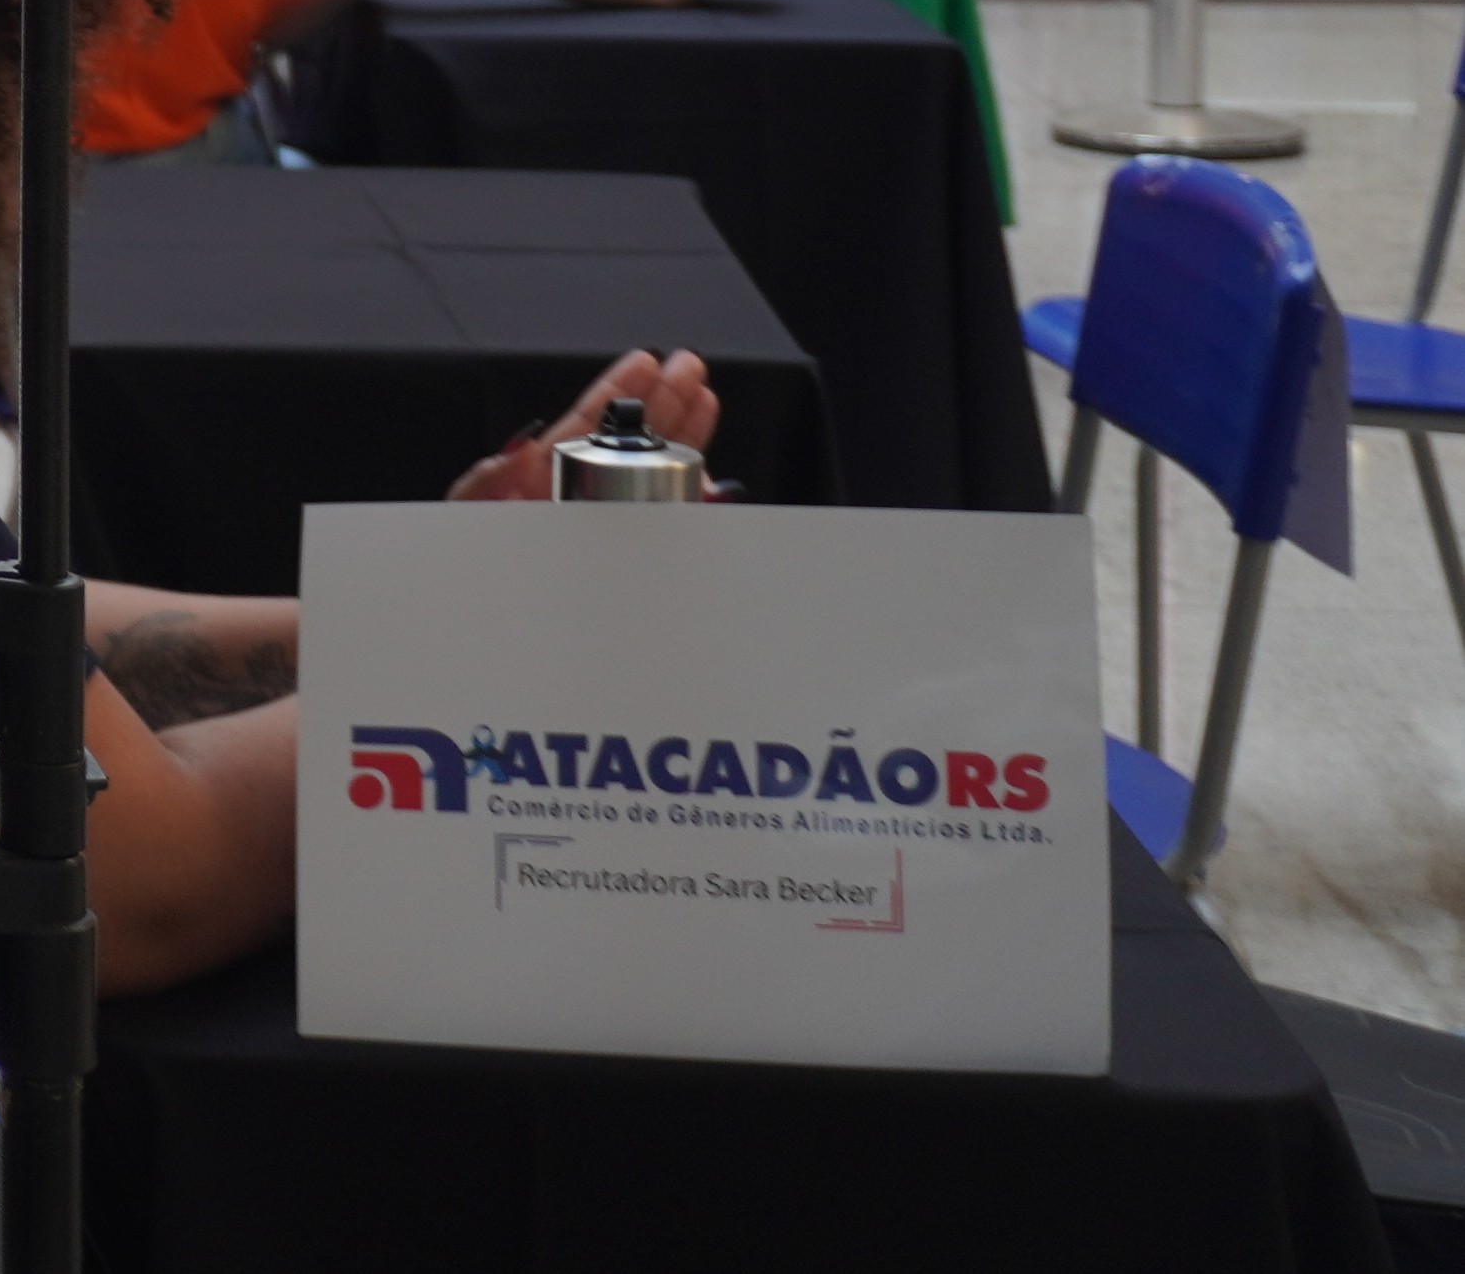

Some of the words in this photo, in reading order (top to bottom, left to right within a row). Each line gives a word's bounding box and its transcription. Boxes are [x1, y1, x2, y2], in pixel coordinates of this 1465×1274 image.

[486, 794, 618, 822] Comércio
[626, 801, 658, 824] de
[667, 803, 784, 831] Gêneros
[980, 819, 1054, 846] Ltda.
[517, 860, 699, 898] Recrutadora
[704, 870, 772, 902] Sara
[776, 874, 879, 906] Becker
